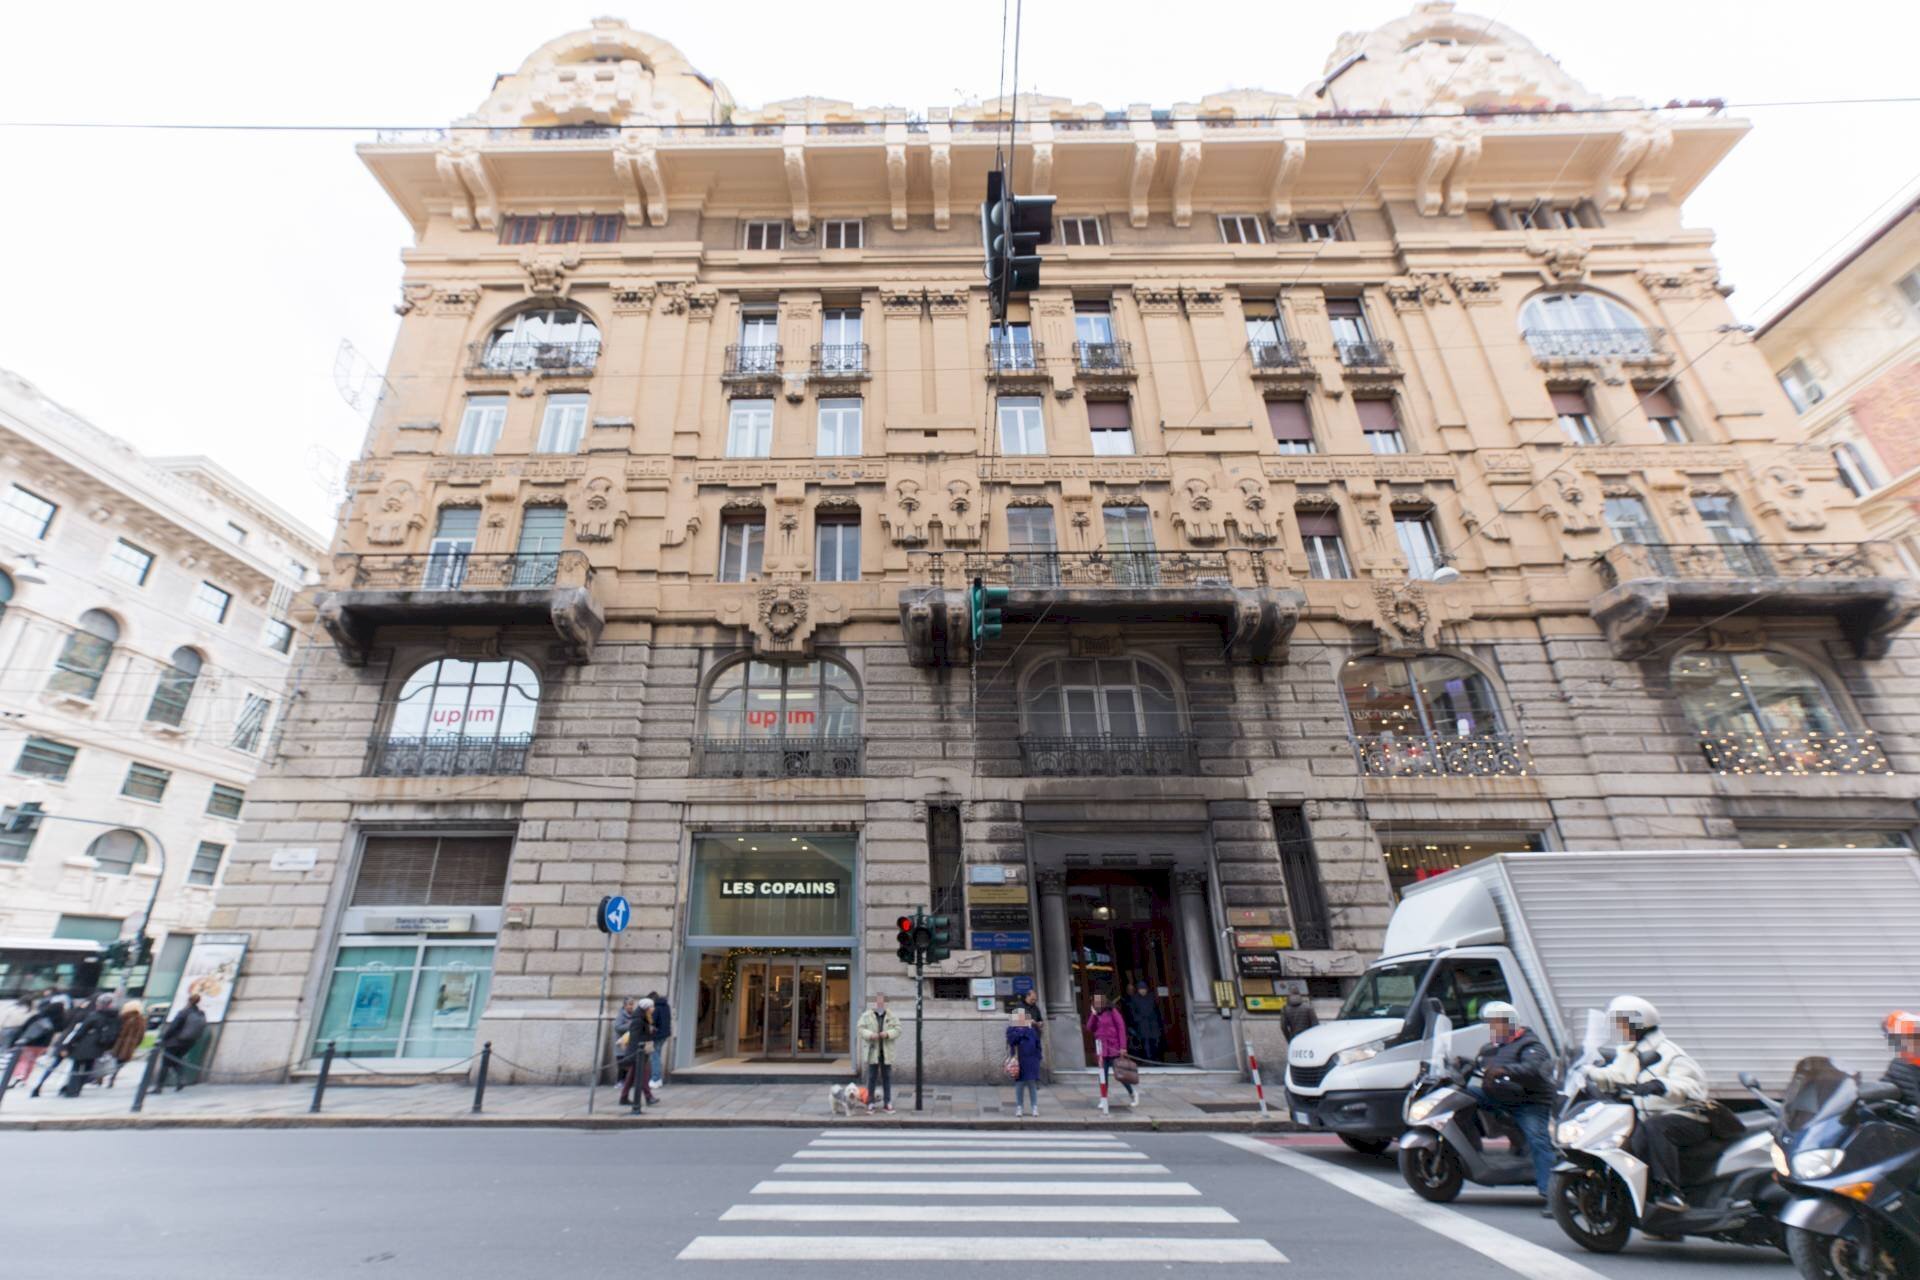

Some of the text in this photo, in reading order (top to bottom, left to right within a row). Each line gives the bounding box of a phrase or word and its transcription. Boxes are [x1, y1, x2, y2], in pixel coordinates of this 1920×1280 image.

[433, 708, 495, 726] upim
[748, 710, 815, 728] upim
[722, 882, 836, 895] LES COPAINS
[1292, 1049, 1315, 1059] IVECO
